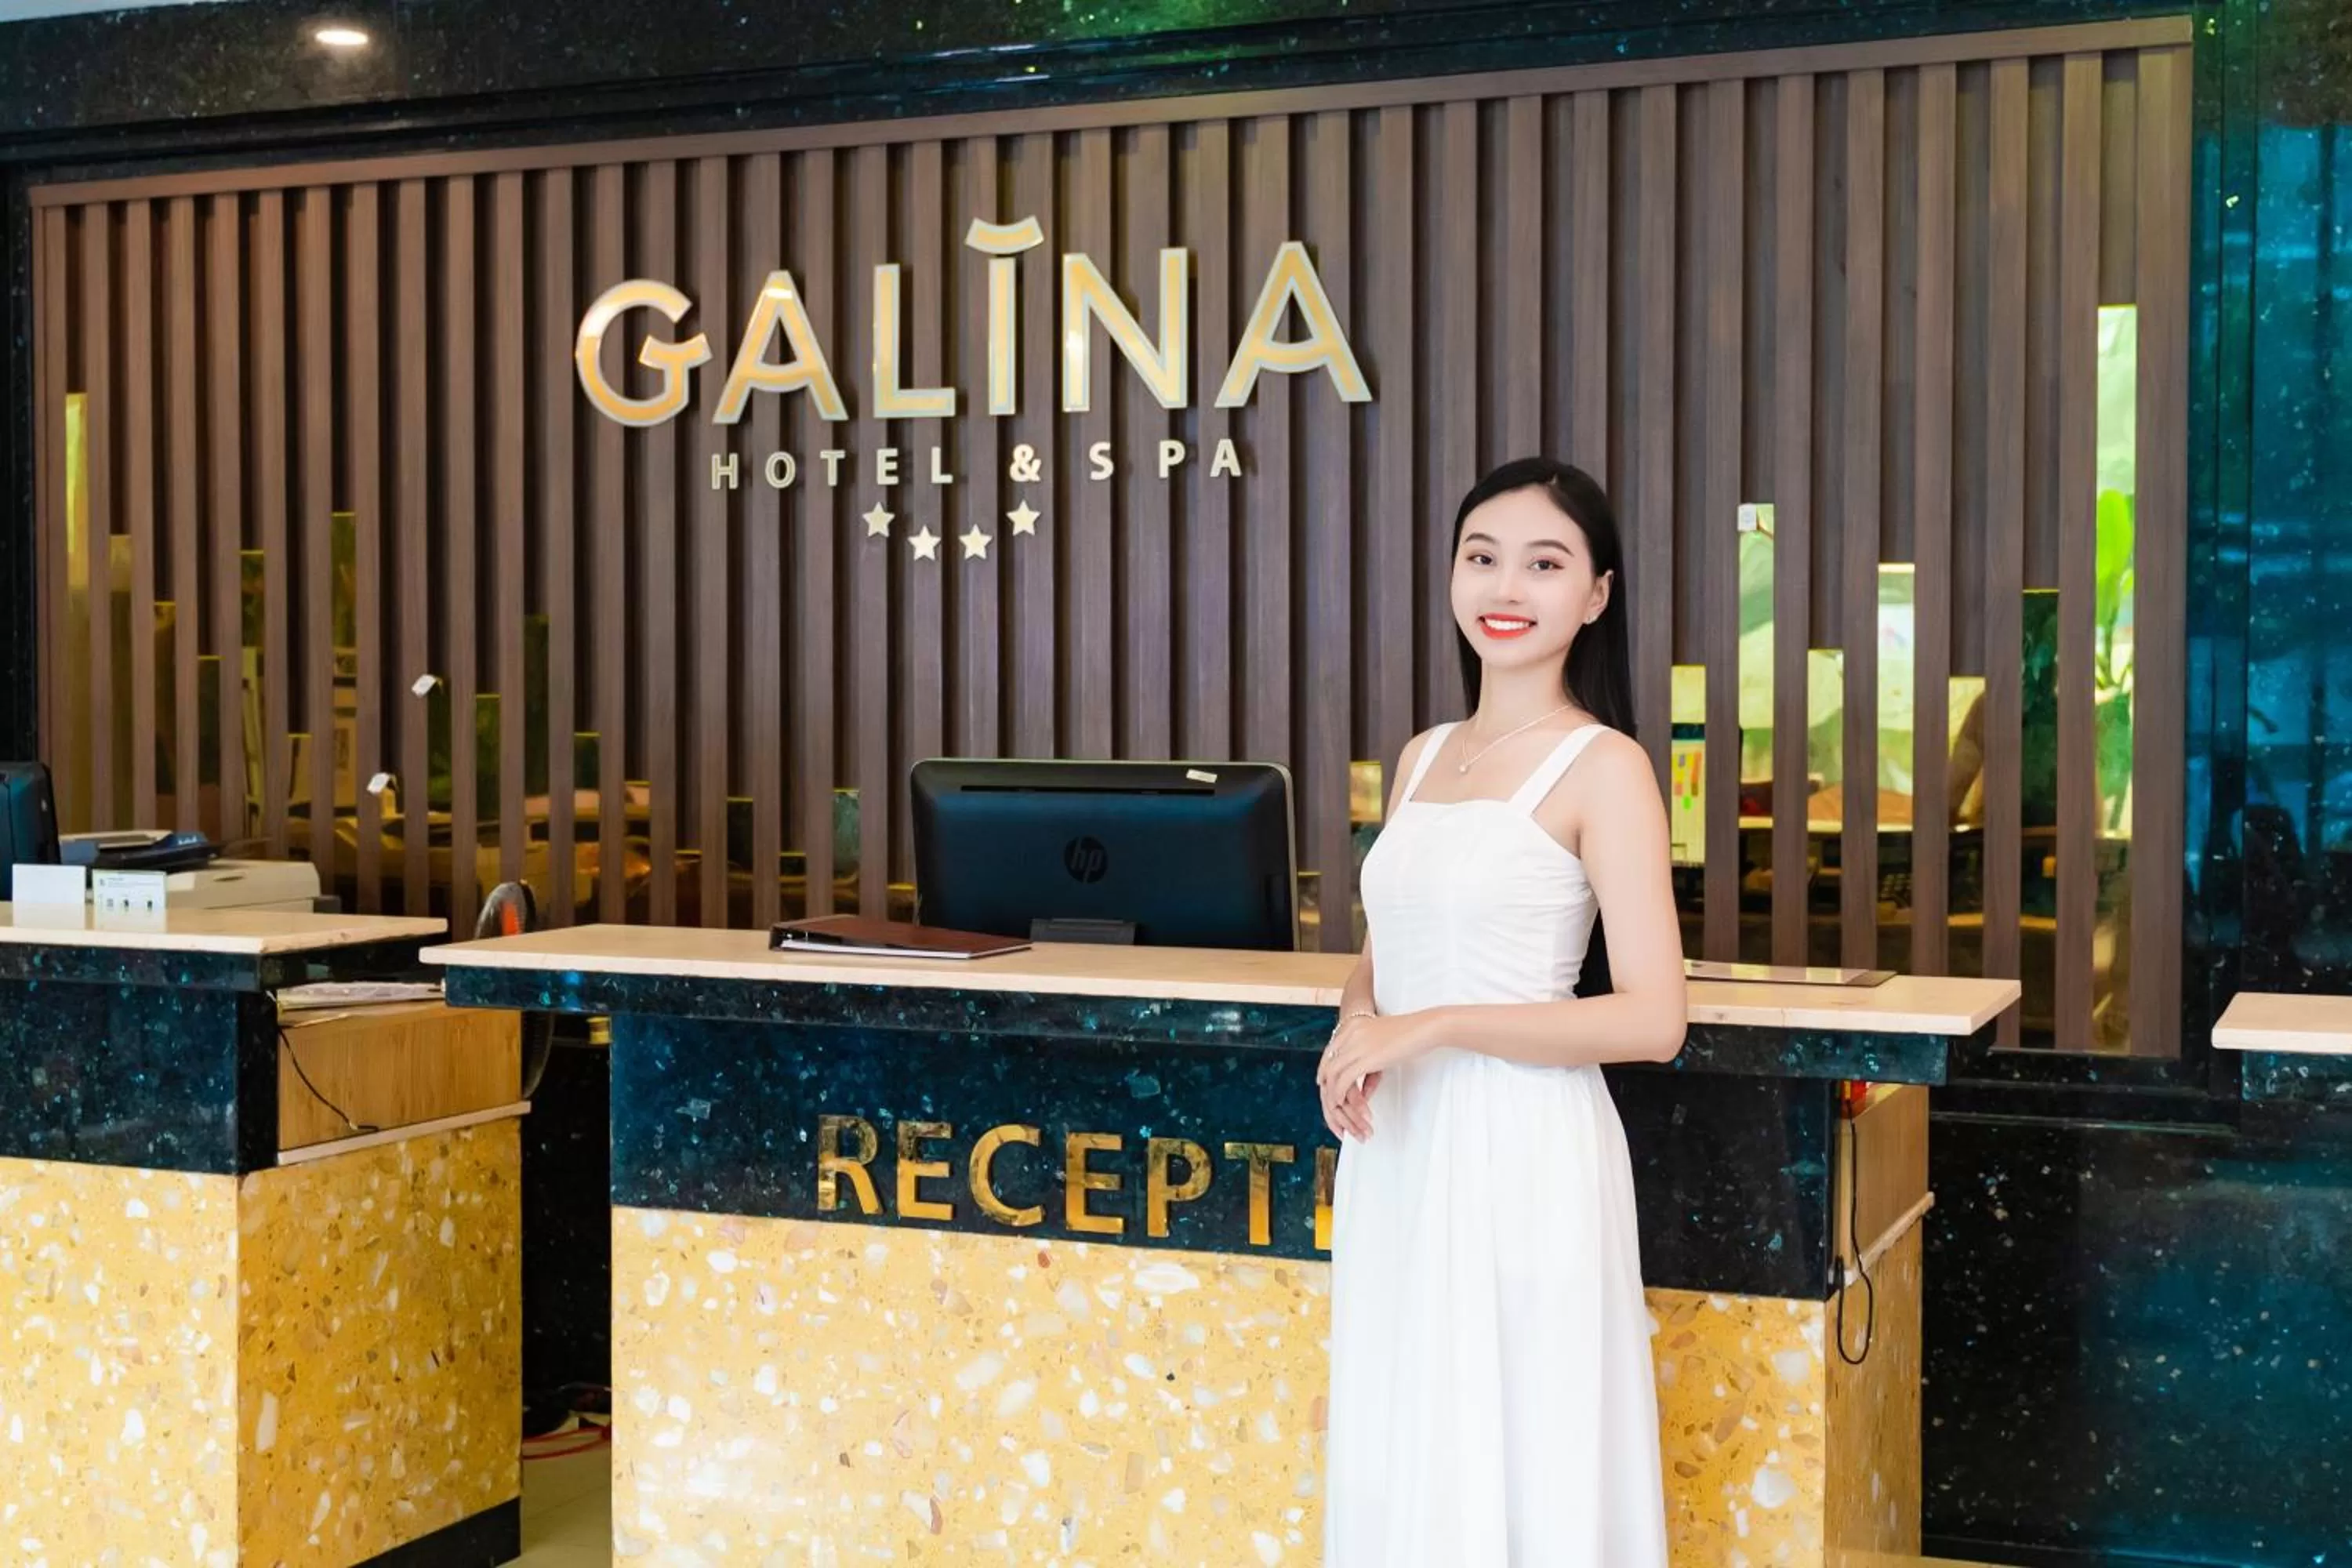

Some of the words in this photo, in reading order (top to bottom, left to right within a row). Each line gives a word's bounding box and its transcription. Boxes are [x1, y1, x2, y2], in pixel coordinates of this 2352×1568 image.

[710, 445, 954, 490] HOTEL
[1008, 443, 1042, 483] &
[1088, 437, 1243, 481] SPA
[1069, 837, 1102, 884] hp
